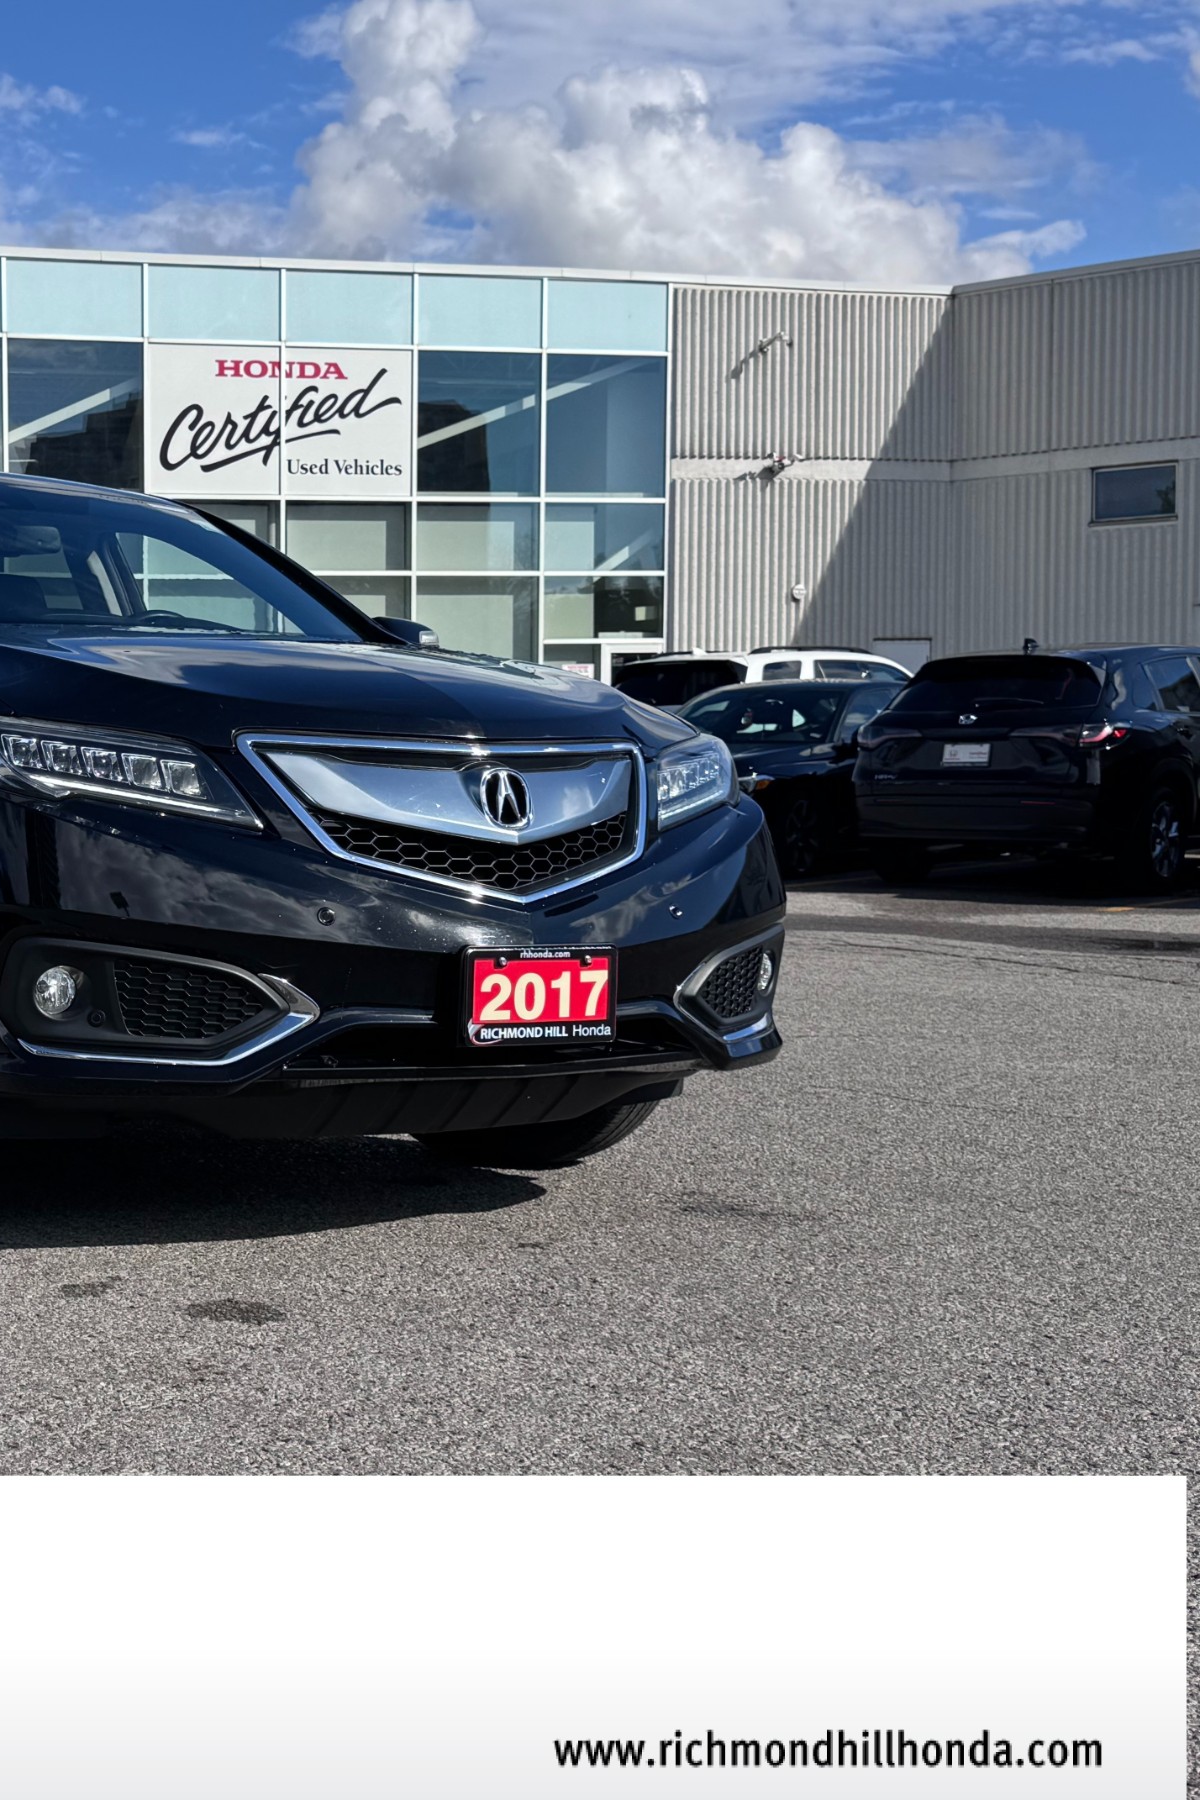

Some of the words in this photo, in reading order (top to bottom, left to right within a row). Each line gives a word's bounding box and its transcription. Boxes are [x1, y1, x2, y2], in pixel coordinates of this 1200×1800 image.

[215, 360, 348, 380] HONDA
[159, 367, 402, 473] Certified
[286, 458, 329, 475] Used
[333, 459, 402, 476] Vehicles
[520, 950, 571, 959] rhhonda.com
[479, 969, 609, 1021] 2017
[480, 1026, 543, 1040] RICHMOND
[544, 1025, 569, 1038] HILL
[572, 1023, 611, 1037] Honda
